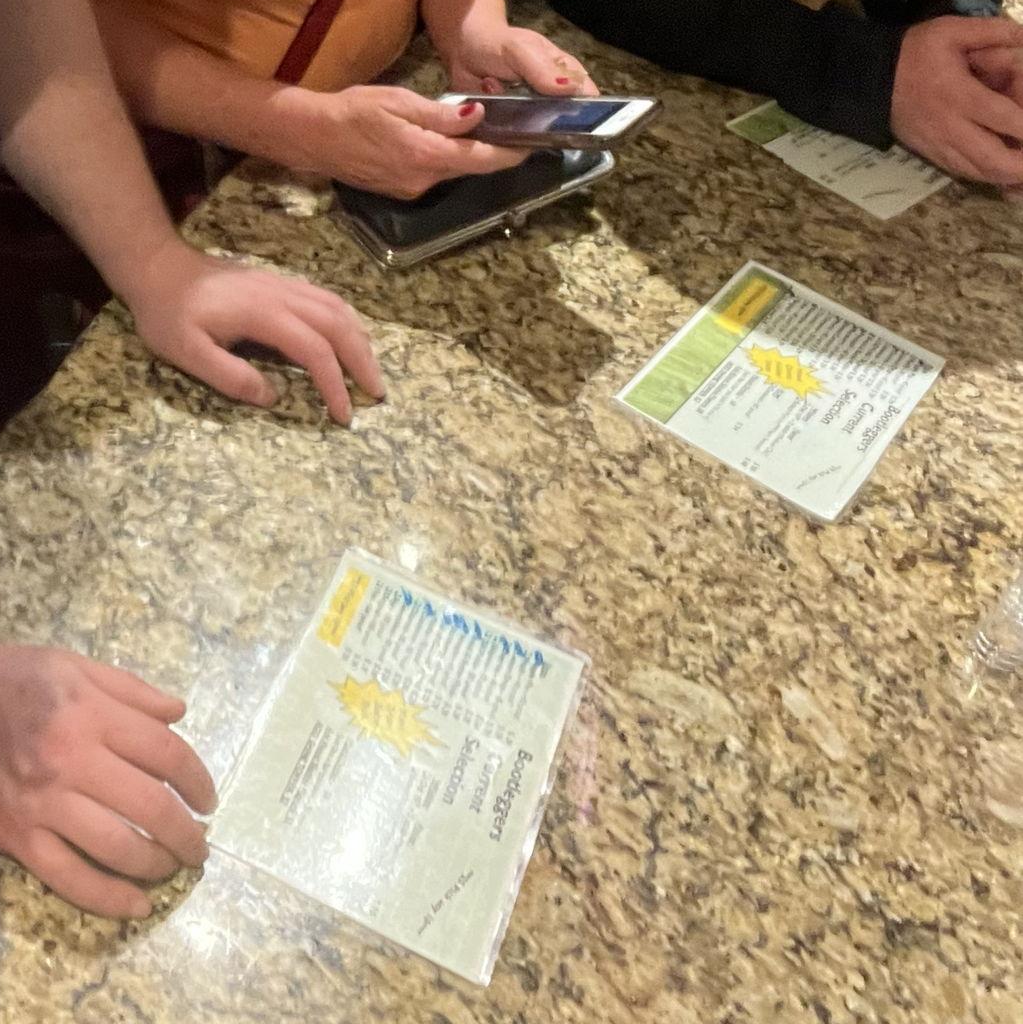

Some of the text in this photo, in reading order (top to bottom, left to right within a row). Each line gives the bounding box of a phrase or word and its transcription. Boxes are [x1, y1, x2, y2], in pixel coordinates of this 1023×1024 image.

[820, 388, 857, 425] Selection
[841, 402, 874, 434] Current
[857, 404, 901, 453] Bootleggers
[442, 736, 480, 805] Selection
[489, 748, 533, 842] Bootleggers
